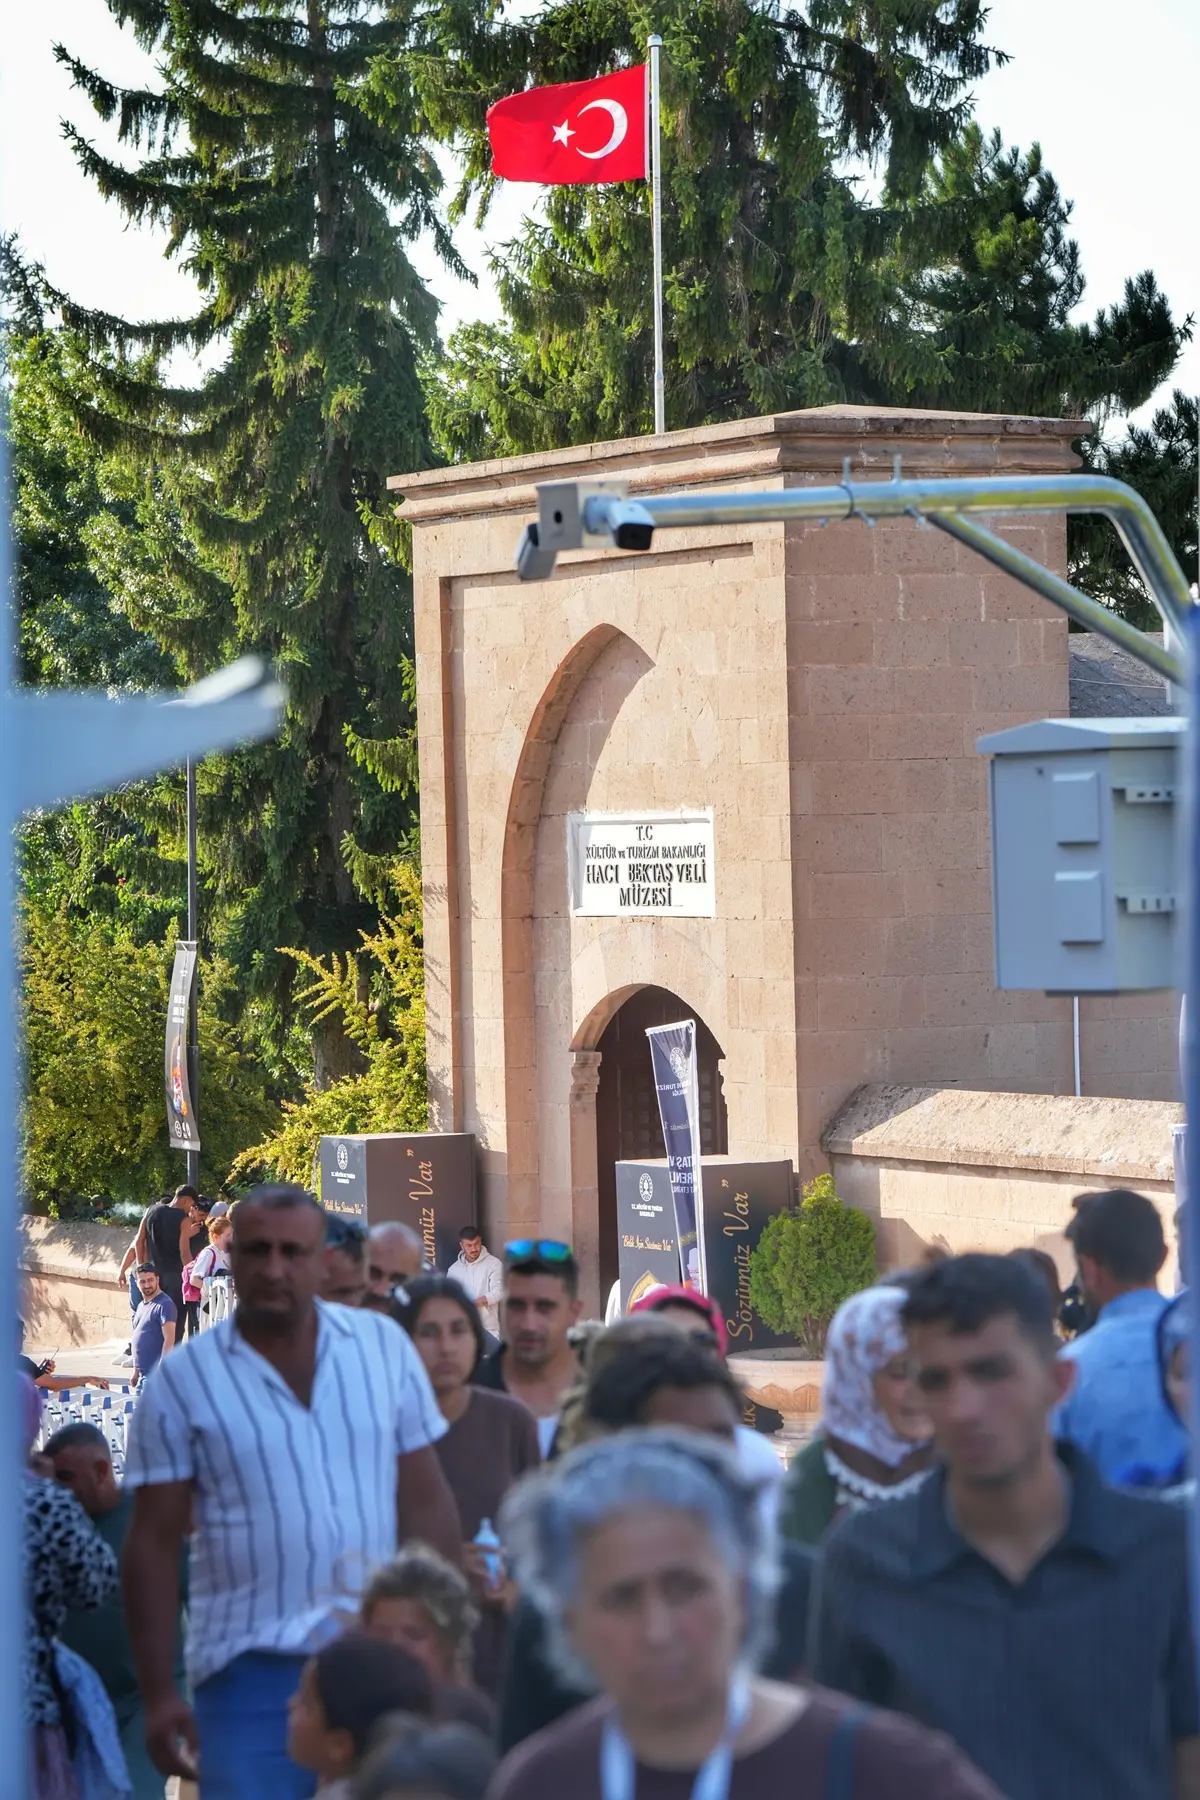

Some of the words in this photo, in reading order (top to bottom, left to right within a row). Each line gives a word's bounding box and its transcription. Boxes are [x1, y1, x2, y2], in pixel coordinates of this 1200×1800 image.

[585, 844, 617, 859] KÜLTÜR
[626, 843, 660, 859] TURİZM
[661, 842, 706, 859] BAKANLIĞI
[586, 864, 619, 884] HACI
[628, 862, 674, 884] BEKTAŞ
[676, 859, 707, 884] VELİ
[619, 882, 672, 907] MÜZESİ
[726, 1244, 753, 1342] Sözümüz
